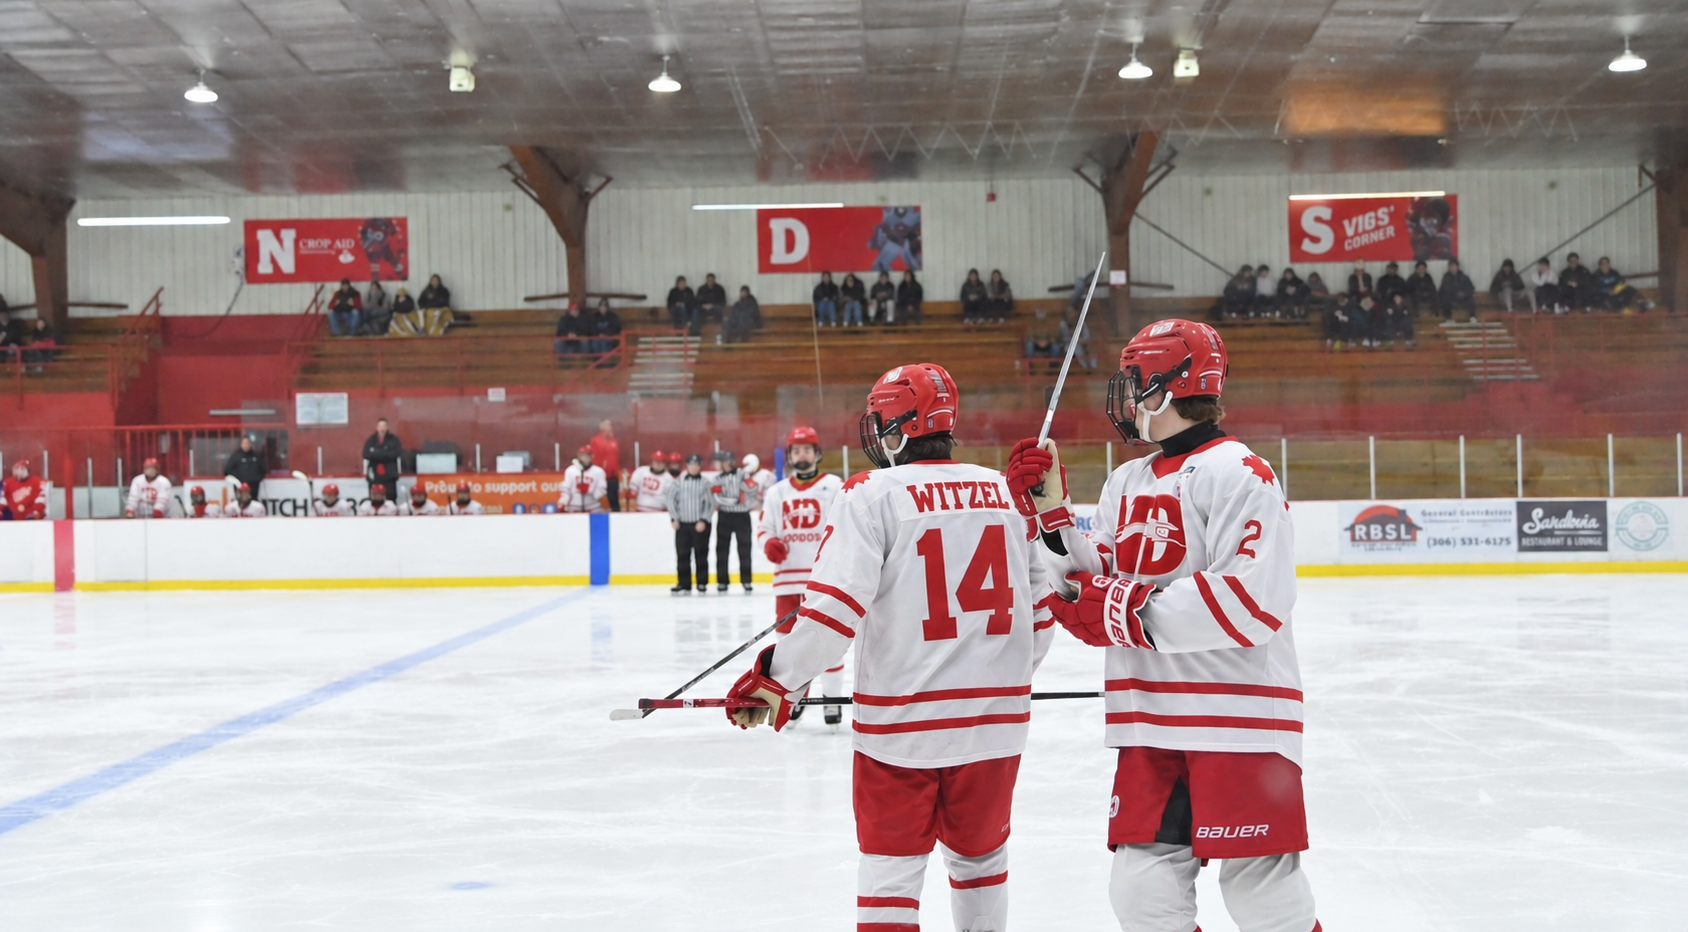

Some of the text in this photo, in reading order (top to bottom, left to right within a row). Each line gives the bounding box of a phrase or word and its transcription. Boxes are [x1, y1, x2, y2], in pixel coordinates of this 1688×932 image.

[1301, 205, 1334, 255] S
[1342, 204, 1395, 237] VIGS'
[256, 228, 297, 274] N
[299, 238, 355, 249] CROP AID
[769, 218, 810, 265] D
[1344, 225, 1396, 251] CORNER
[425, 481, 456, 494] Prou
[484, 481, 537, 495] support
[906, 481, 1010, 513] WITZEL
[1236, 518, 1262, 559] 2
[1354, 523, 1412, 541] RBSL
[1426, 537, 1456, 549] (306)
[1460, 537, 1512, 546] 531-6175
[1521, 536, 1565, 547] RESTAURANT
[1574, 536, 1602, 546] LOUNGE
[915, 524, 1014, 641] 14
[1195, 824, 1269, 838] BAUER
